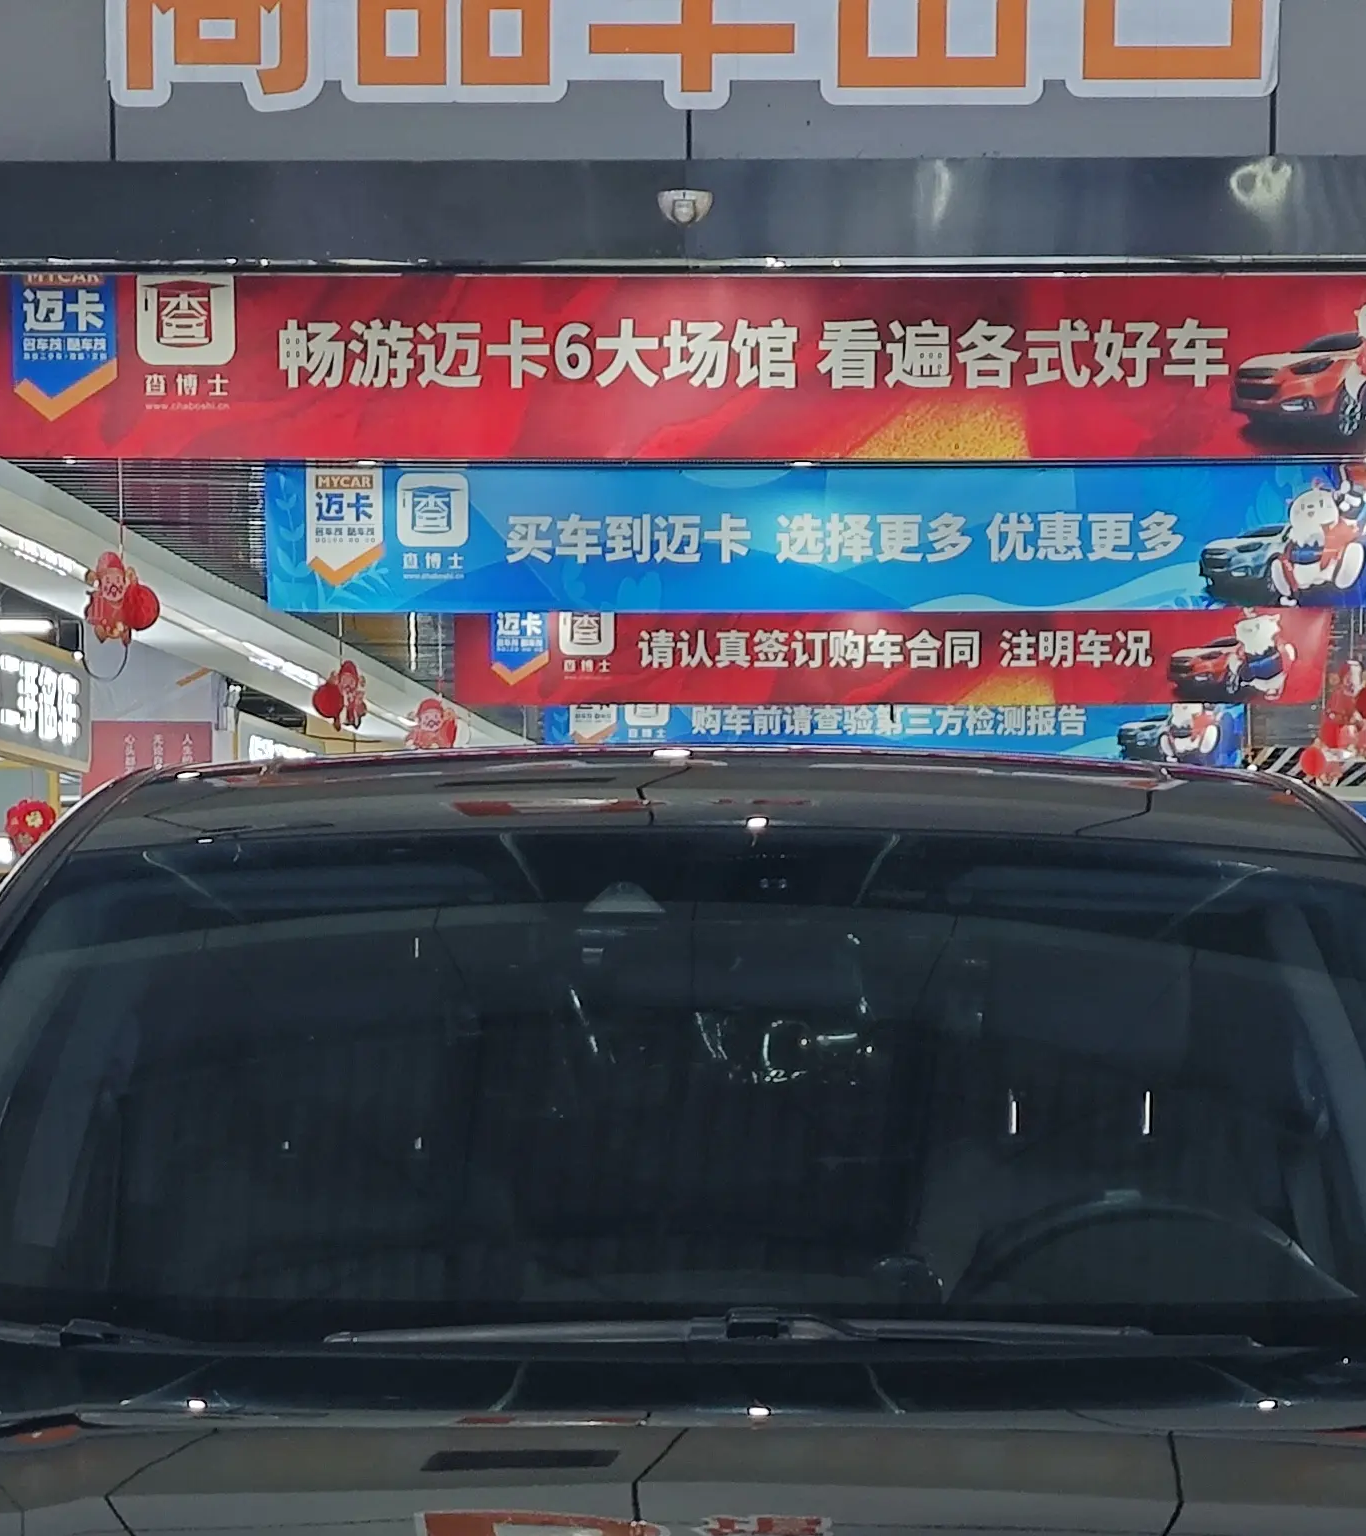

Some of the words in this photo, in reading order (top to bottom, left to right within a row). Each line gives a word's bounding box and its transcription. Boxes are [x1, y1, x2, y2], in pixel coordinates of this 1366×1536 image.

[23, 288, 105, 332] 迈卡
[278, 318, 797, 390] 畅游迈卡6大场馆
[818, 317, 1230, 391] 看遍各式好车
[145, 373, 229, 396] 查博士
[317, 475, 372, 488] MYCAR
[315, 491, 374, 522] 迈卡
[506, 514, 752, 565] 买车到迈卡
[776, 512, 971, 564] 选择更多
[987, 511, 1185, 563] 优惠更多
[402, 552, 464, 570] 查博士
[497, 611, 542, 636] 迈卡
[638, 629, 980, 668] 请认真签订购车合同
[1000, 629, 1152, 668] 注明车况
